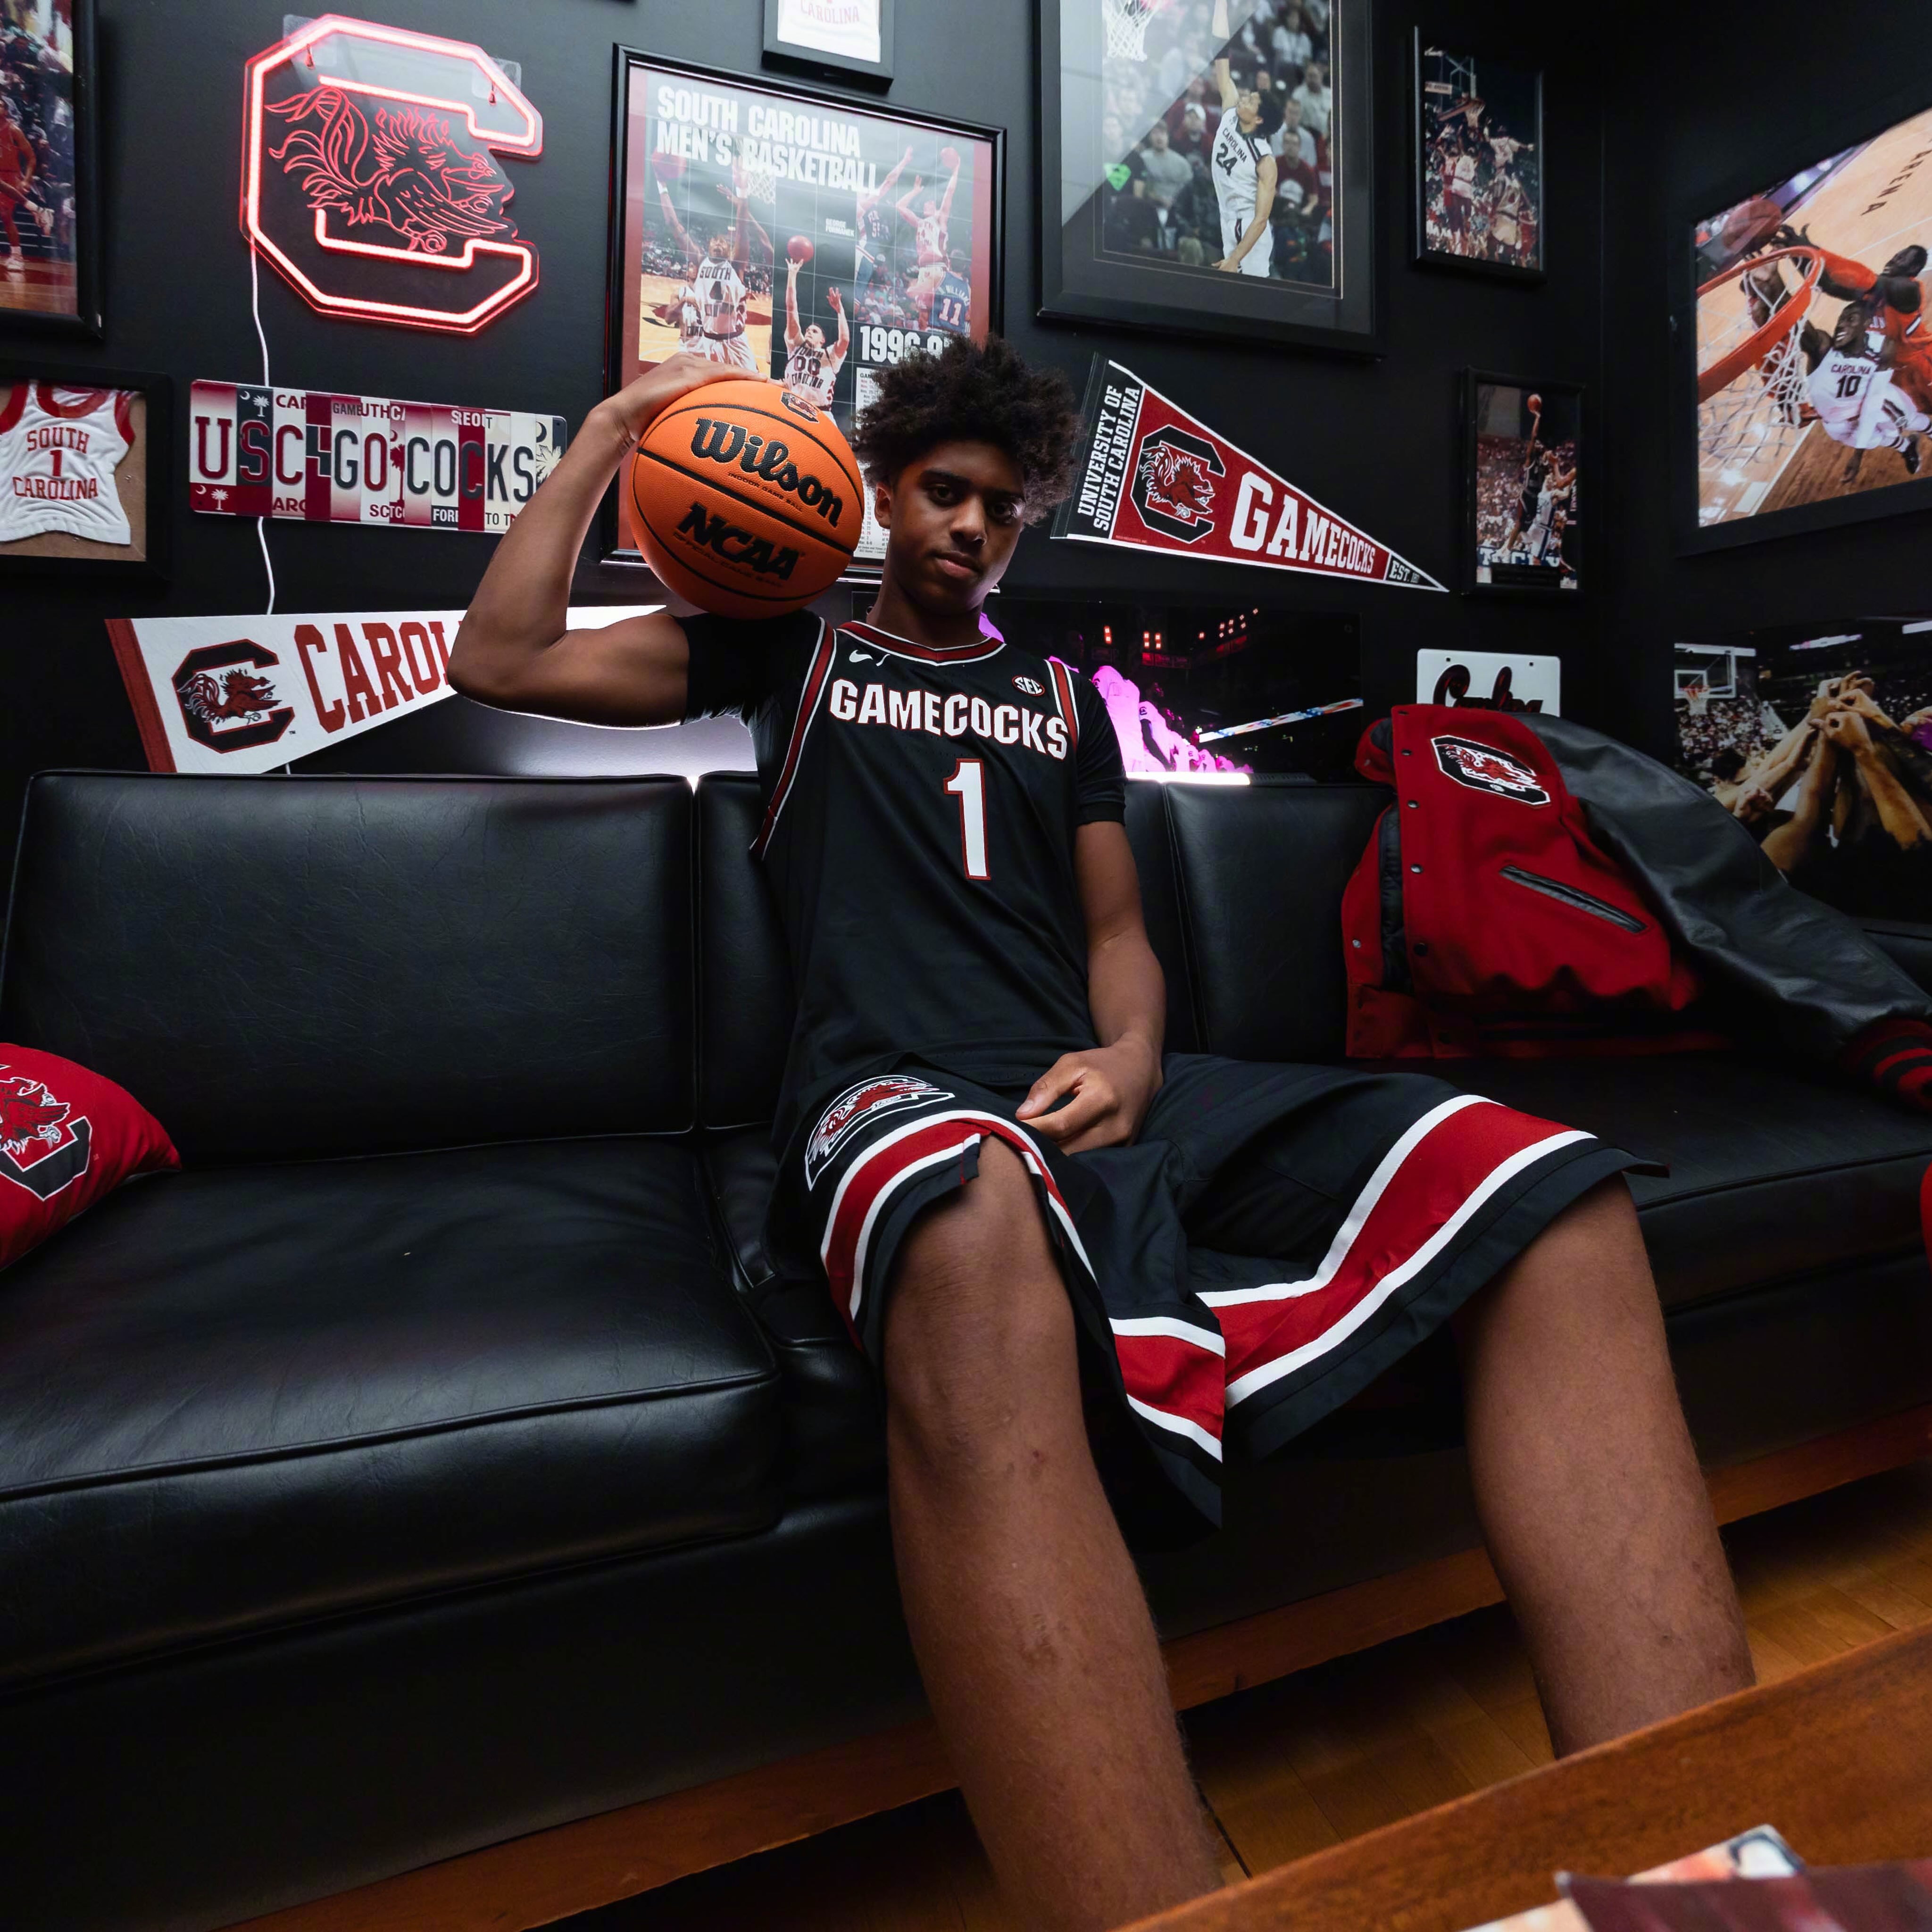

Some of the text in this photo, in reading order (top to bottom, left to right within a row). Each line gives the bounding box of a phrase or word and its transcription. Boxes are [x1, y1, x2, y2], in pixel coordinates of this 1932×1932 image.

[800, 2, 859, 24] CAROLINA
[658, 85, 860, 158] SOUTH CAROLINA
[657, 120, 880, 196] MEN'S BASKETBALL
[1216, 142, 1238, 176] 24
[1223, 127, 1247, 163] CAROLINA
[699, 266, 731, 281] SOUTH
[939, 298, 962, 326] 11
[1831, 364, 1871, 375] CAROLINA
[1835, 375, 1862, 398] 10
[26, 427, 90, 454] SOUTH
[1078, 385, 1123, 516] UNIVERSITY OF
[50, 450, 63, 476] 1
[195, 416, 534, 502] USC GO COCKS
[690, 418, 843, 528] Wilson
[1093, 387, 1140, 531] SOUTH CAROLINA
[12, 476, 99, 500] CAROLINA
[728, 473, 802, 512] INDOOR GAME BALL
[677, 501, 799, 581] NCAA
[1229, 472, 1376, 574] GAMECOCKS
[1389, 560, 1410, 582] EST.
[1014, 676, 1042, 694] SEC
[830, 678, 1071, 760] GAMECOCKS
[944, 758, 991, 881] 1
